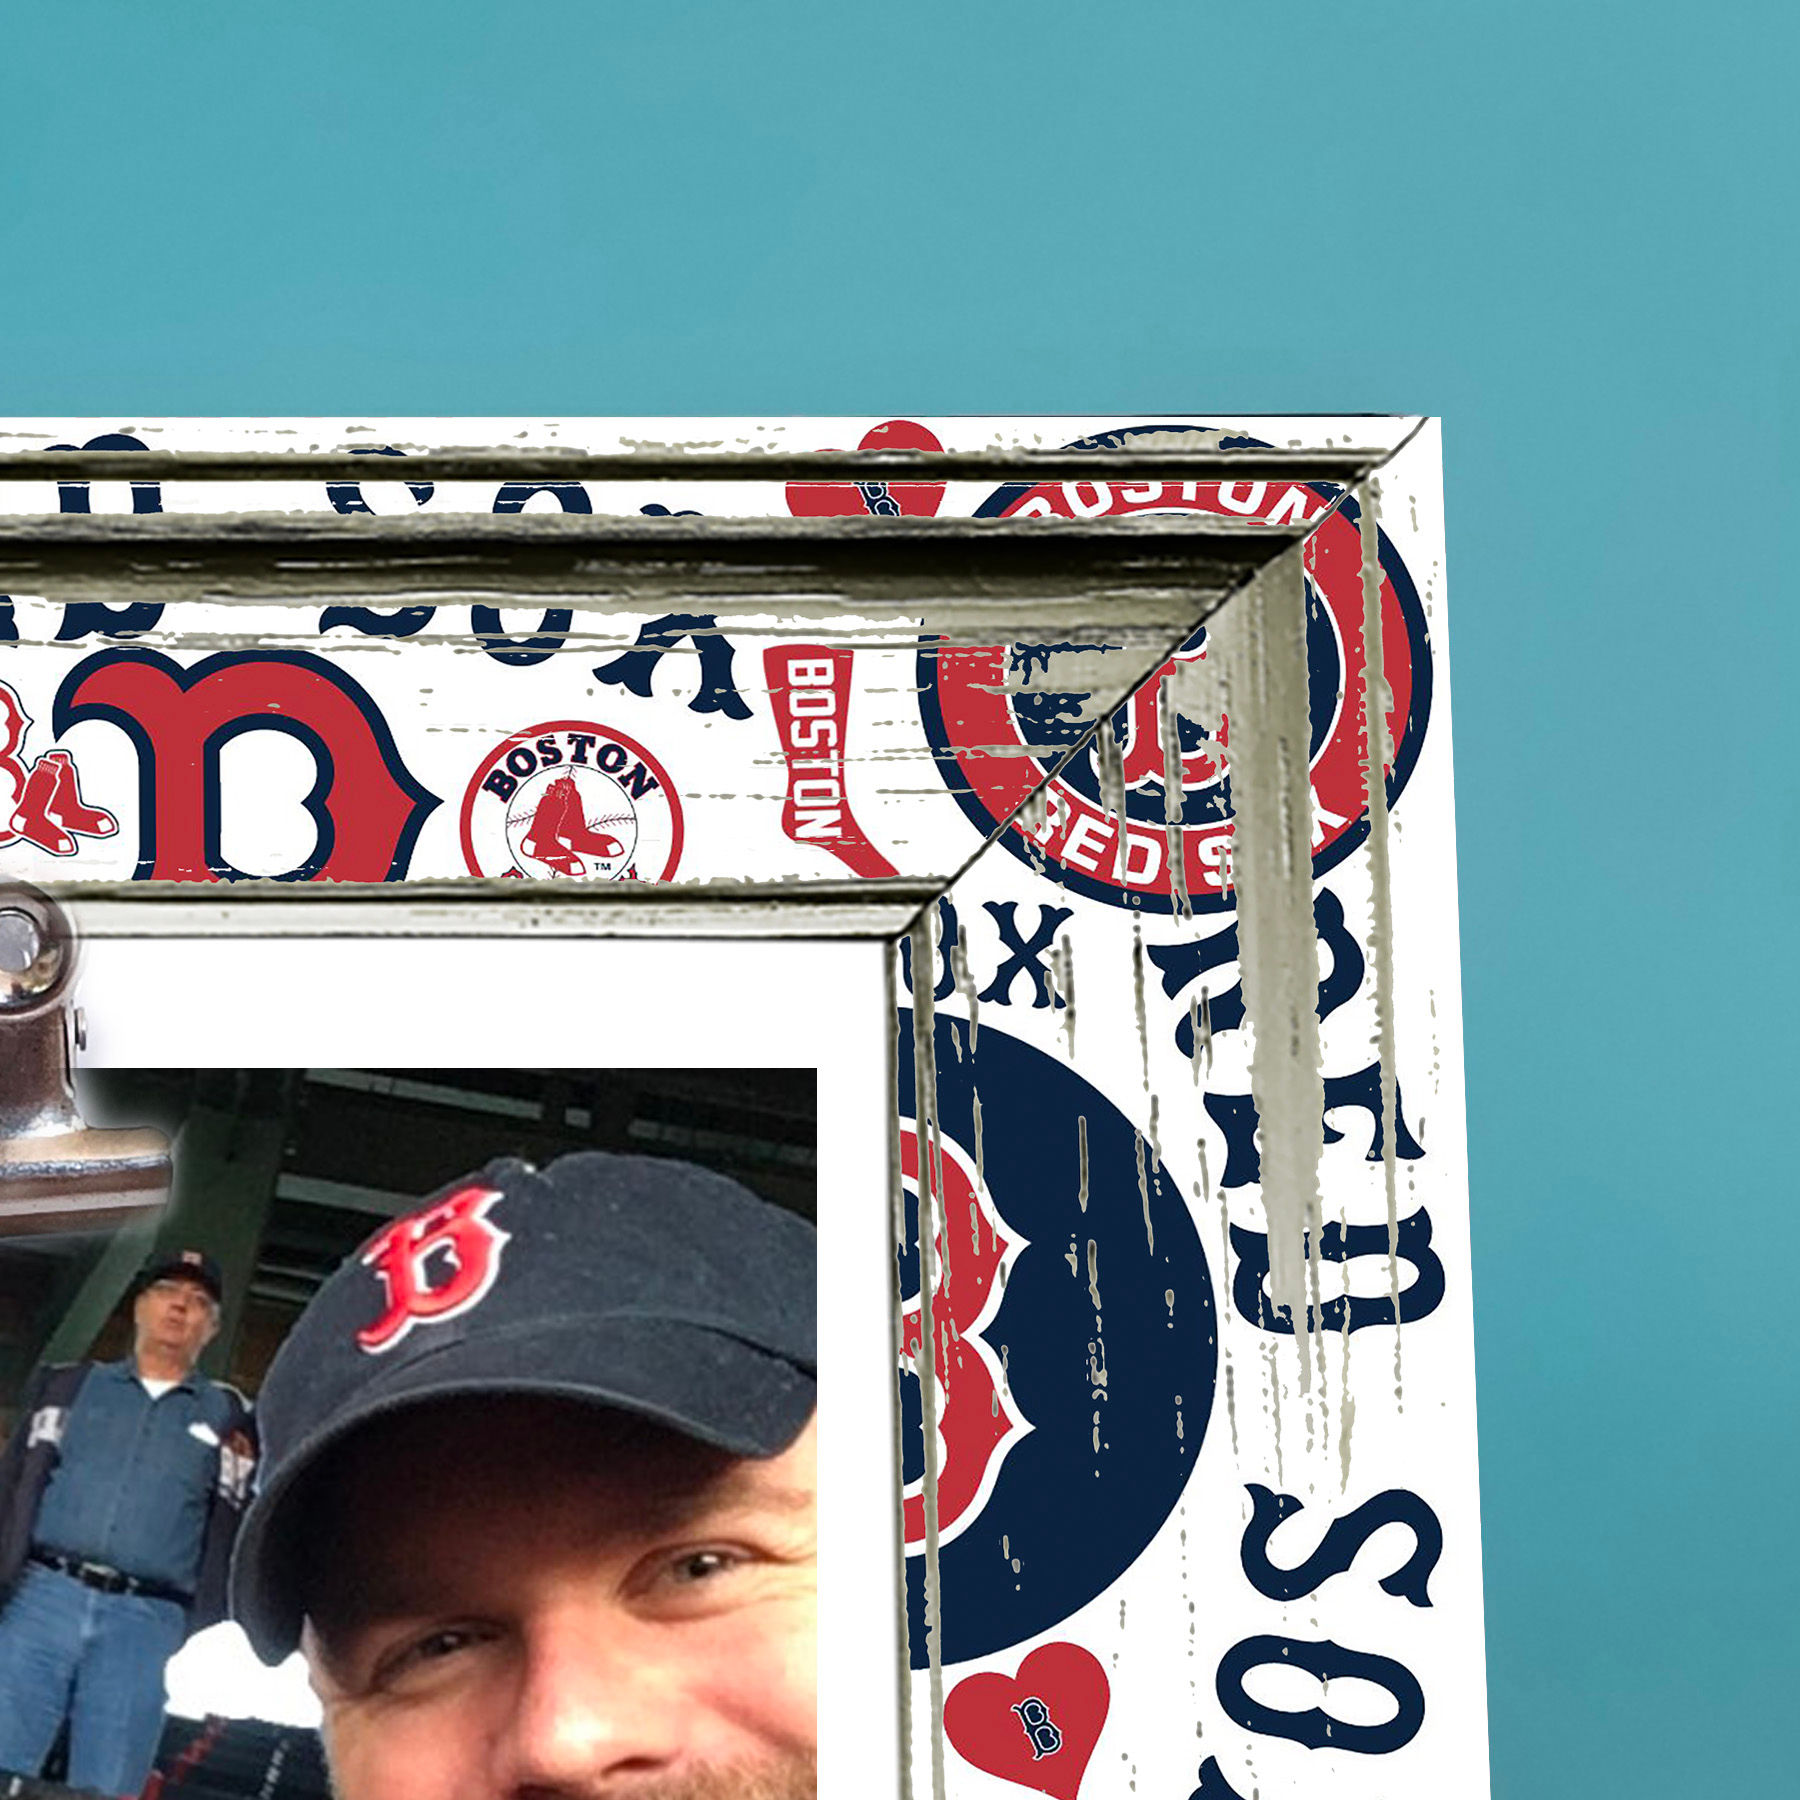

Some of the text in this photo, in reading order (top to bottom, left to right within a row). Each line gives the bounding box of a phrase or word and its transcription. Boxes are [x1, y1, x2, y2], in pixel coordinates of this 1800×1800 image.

[482, 733, 660, 804] BOSTON
[786, 657, 844, 840] BOSTON
[358, 1188, 512, 1355] B
[1011, 1696, 1062, 1761] B
